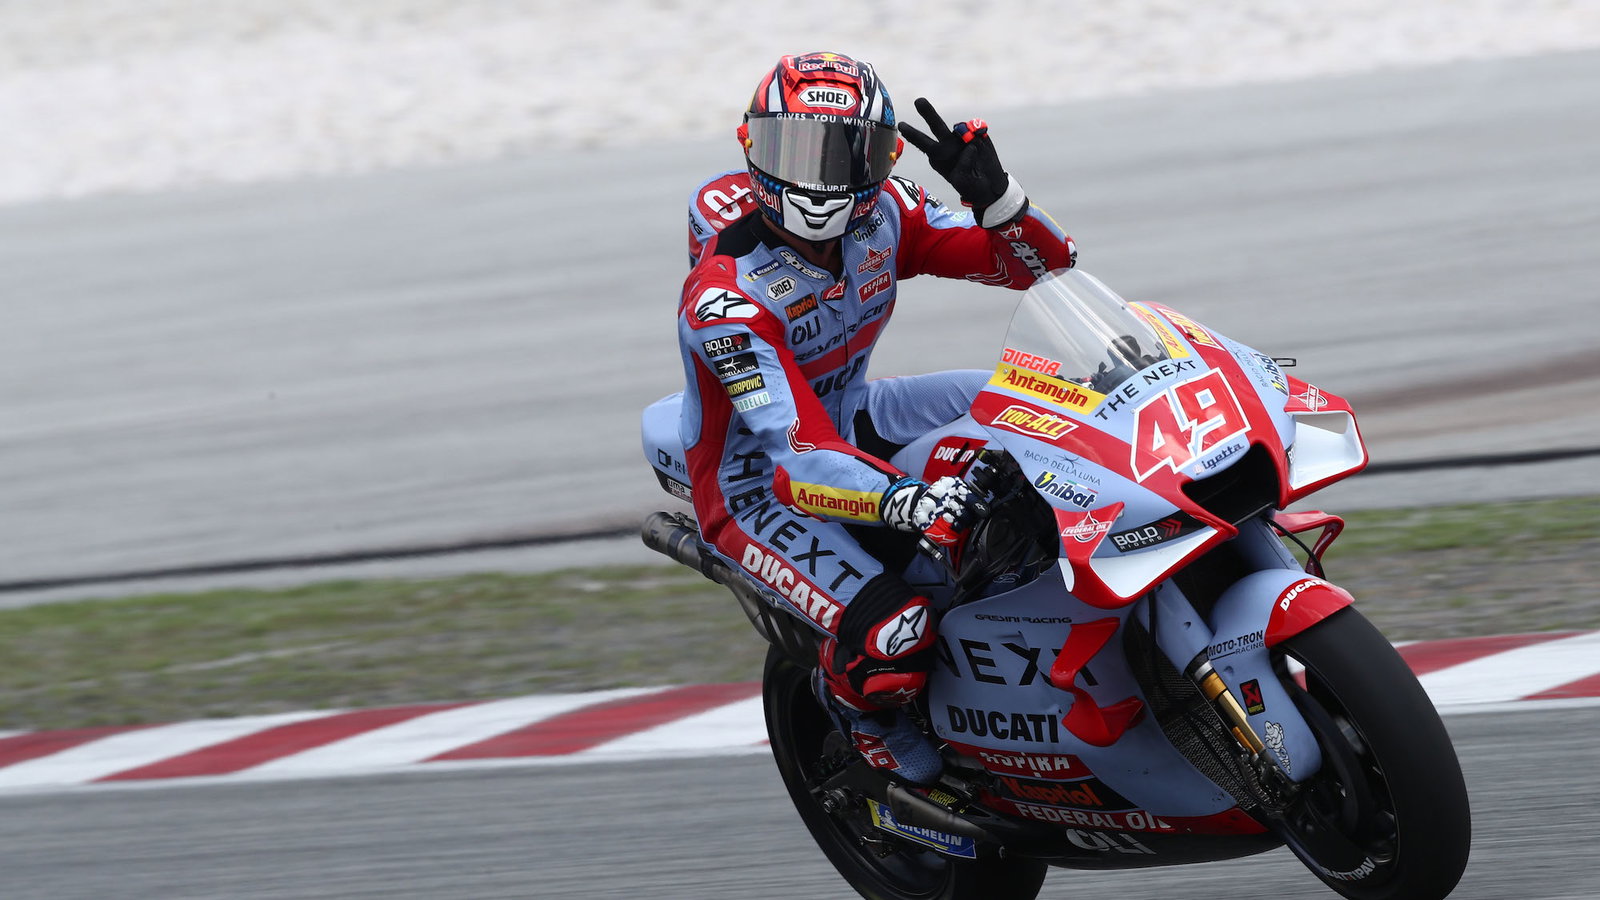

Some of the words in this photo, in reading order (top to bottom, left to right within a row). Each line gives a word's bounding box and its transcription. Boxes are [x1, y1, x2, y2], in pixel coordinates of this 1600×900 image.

[807, 90, 848, 105] SHOEI
[776, 112, 806, 121] GIVES
[812, 114, 836, 123] YOU
[842, 116, 877, 129] WINGS
[852, 211, 886, 243] Unibat
[756, 262, 779, 275] MICHELIN
[770, 278, 793, 297] SHOEI
[863, 275, 888, 296] ASPIRA
[786, 294, 817, 320] Kapriol
[791, 316, 821, 345] OLI
[705, 337, 732, 352] BOLD
[725, 369, 742, 378] DELLA
[742, 365, 757, 374] LUNA
[1001, 347, 1062, 376] DIGGIA
[1003, 369, 1089, 407] Antangin
[1095, 384, 1140, 421] THE
[1142, 359, 1197, 385] NEXT
[1130, 367, 1252, 484] 49
[934, 446, 975, 463] DUCTI
[1023, 450, 1049, 465] BACIO
[1050, 459, 1078, 476] DELLA
[1078, 471, 1101, 485] LUNA
[796, 488, 876, 517] Antangin
[1033, 470, 1097, 509] Unibat
[1065, 524, 1095, 535] FEDERAL
[1095, 522, 1108, 531] OIL
[1113, 526, 1159, 546] BOLD
[1120, 536, 1162, 550] RIDERS
[742, 544, 840, 627] DUCATI
[974, 614, 1021, 623] GRESINI
[1022, 616, 1073, 624] RACING
[1206, 630, 1264, 658] MOTO-TRON
[1235, 641, 1265, 655] RACING
[946, 705, 1060, 744] DUCATI
[1000, 776, 1104, 806] Kapriol
[1014, 803, 1123, 829] FEDERAL
[1065, 829, 1158, 855] OLI
